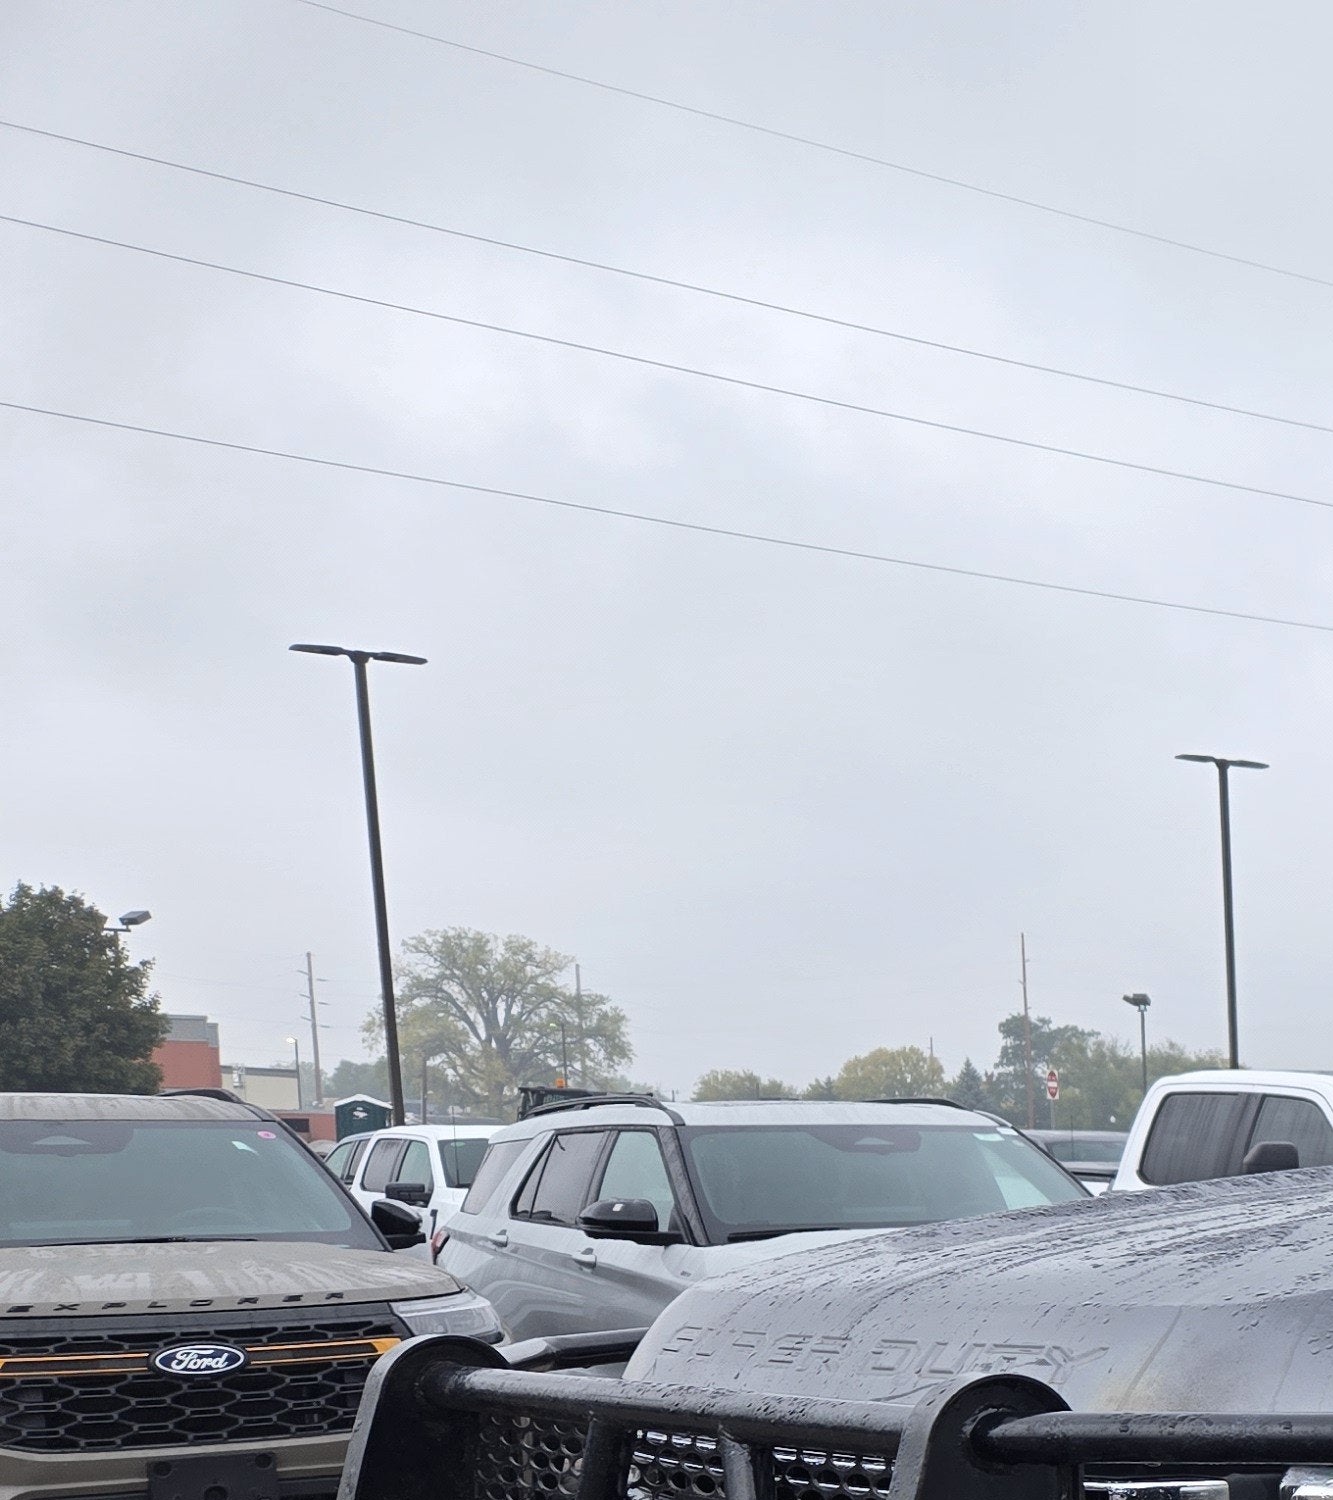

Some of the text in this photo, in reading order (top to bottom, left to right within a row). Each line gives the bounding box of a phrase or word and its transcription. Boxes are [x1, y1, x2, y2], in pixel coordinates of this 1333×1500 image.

[6, 1291, 345, 1314] EXPLORER
[172, 1349, 228, 1370] Ford
[661, 1325, 1110, 1386] SUPER DUTY
